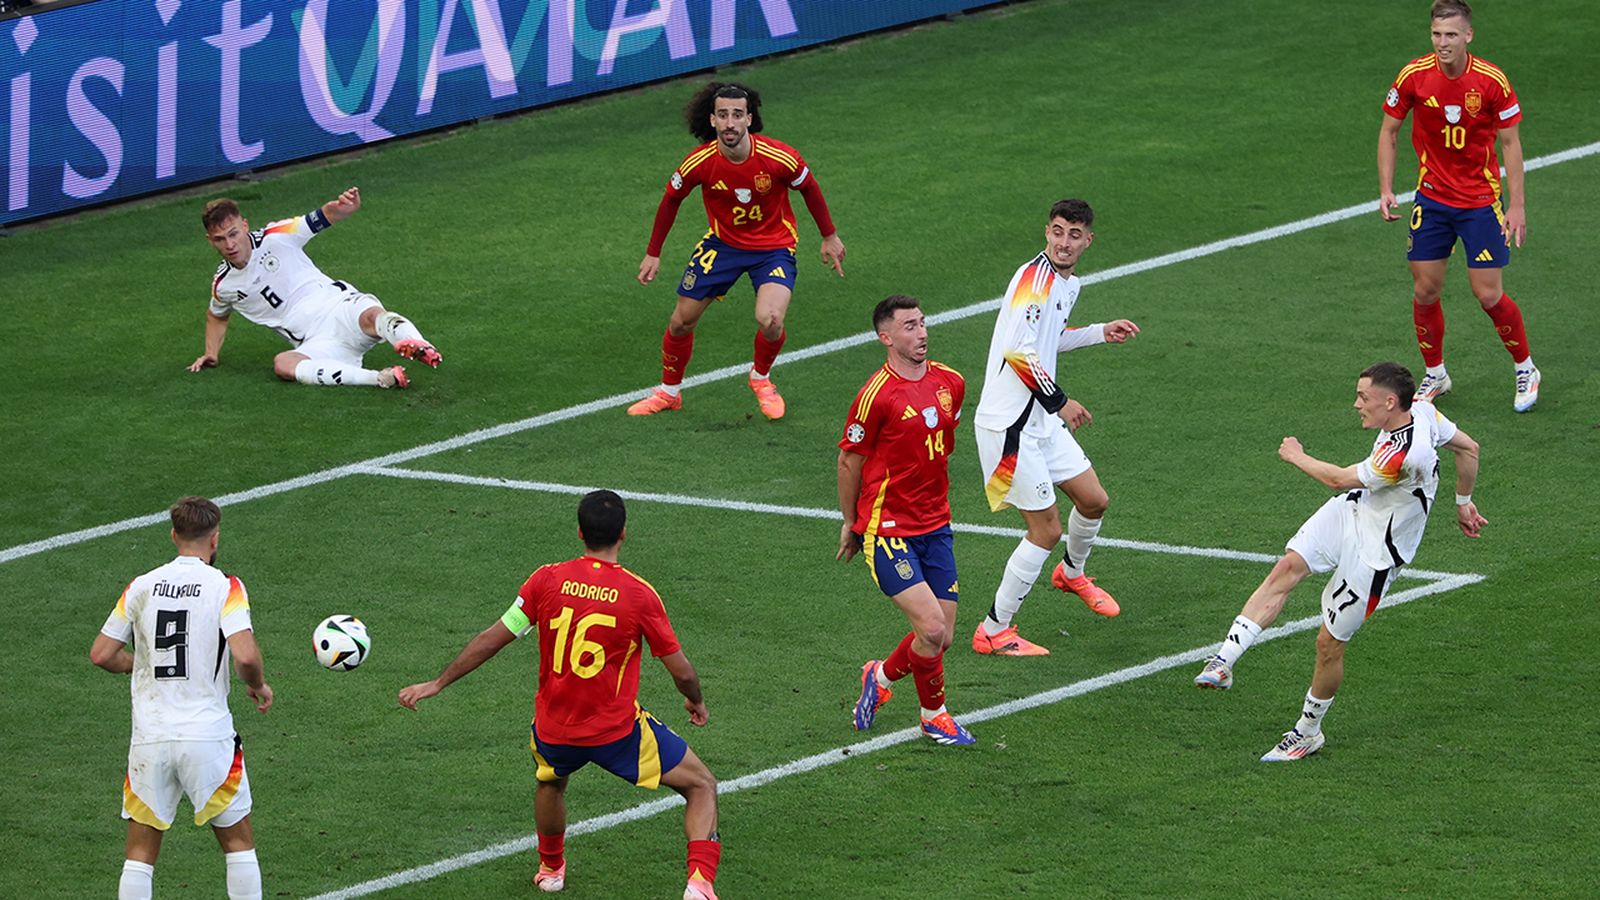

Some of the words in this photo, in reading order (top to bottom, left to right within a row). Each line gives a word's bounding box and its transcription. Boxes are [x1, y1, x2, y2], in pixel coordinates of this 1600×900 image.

[1441, 124, 1466, 150] 10
[732, 204, 763, 226] 24
[1409, 204, 1423, 231] 0
[688, 246, 718, 275] 24
[260, 285, 283, 309] 6
[925, 429, 945, 461] 14
[876, 536, 909, 560] 14
[561, 580, 619, 604] RODRIGO
[1332, 578, 1360, 612] 17
[155, 609, 190, 681] 9
[550, 606, 617, 680] 16
